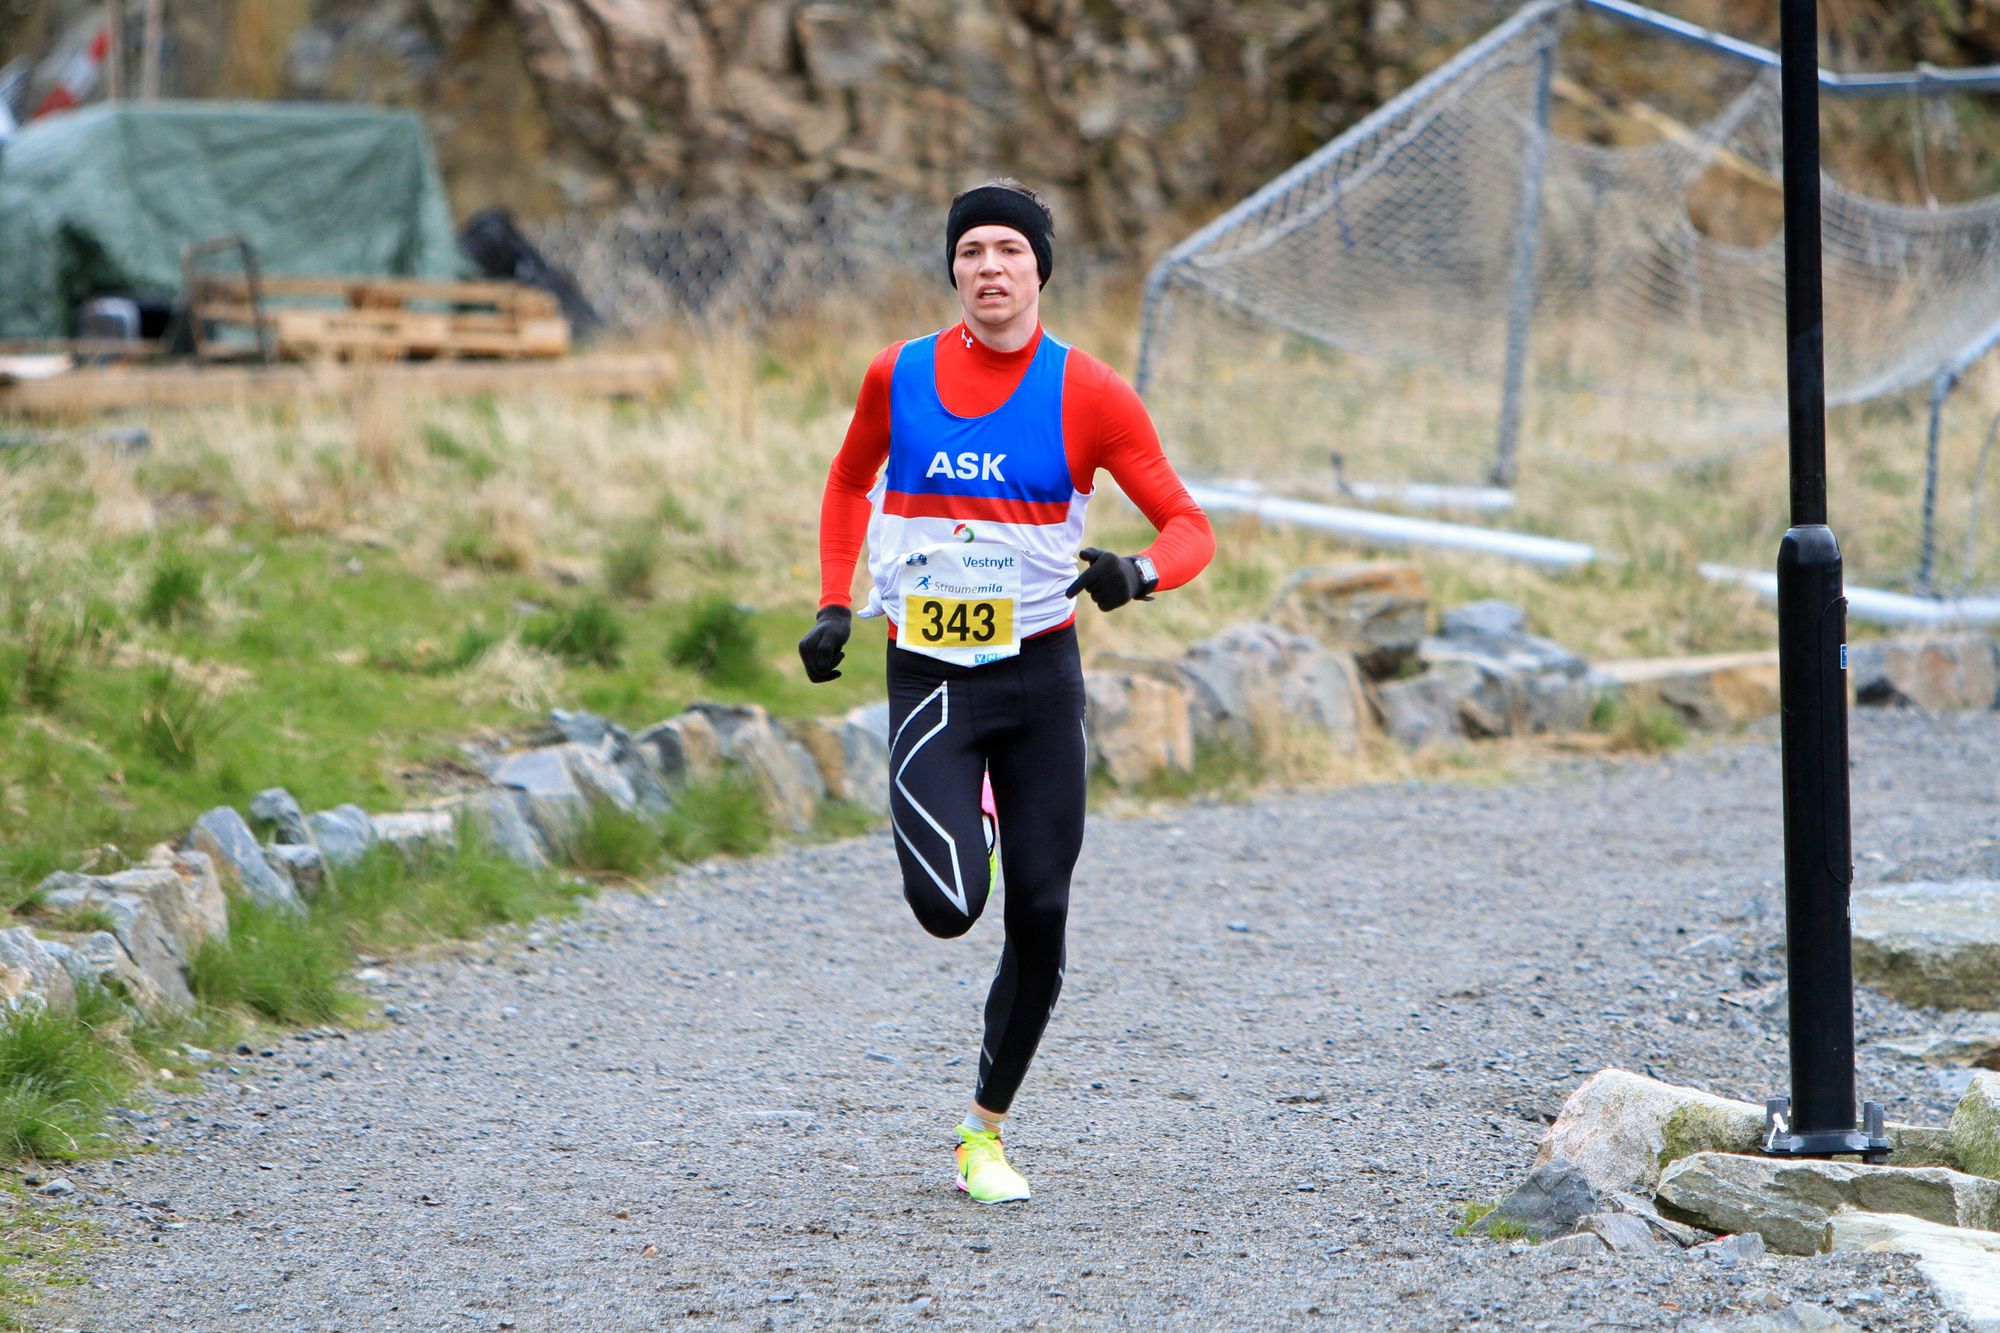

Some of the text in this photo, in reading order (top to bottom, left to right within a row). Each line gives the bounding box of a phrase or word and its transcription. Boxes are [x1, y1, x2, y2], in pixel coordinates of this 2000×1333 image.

[926, 451, 1007, 482] ASK
[962, 556, 1015, 570] Vestnytt
[934, 581, 1003, 594] Straumemila
[921, 600, 996, 642] 343
